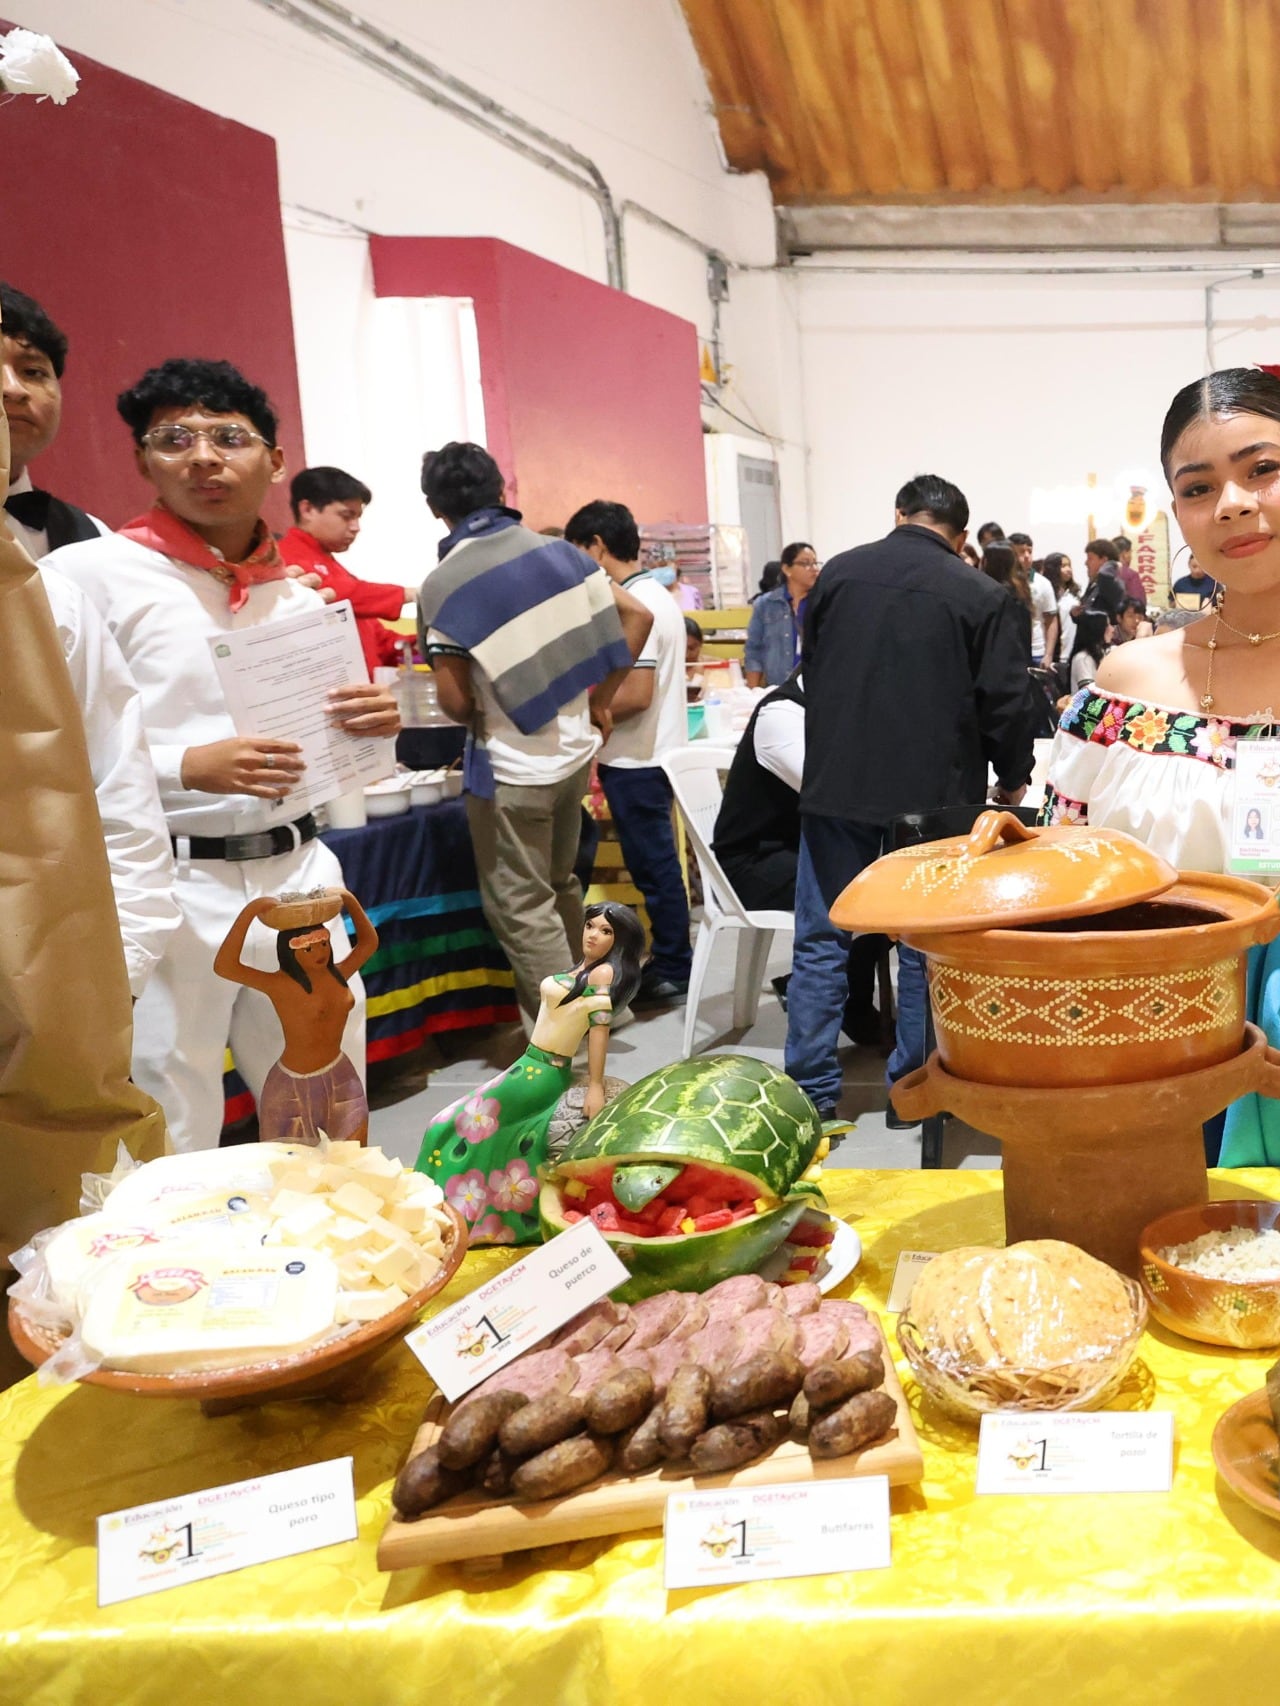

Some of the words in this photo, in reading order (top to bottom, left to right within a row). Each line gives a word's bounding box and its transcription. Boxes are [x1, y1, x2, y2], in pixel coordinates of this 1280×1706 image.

[1137, 529, 1156, 594] FARRAS
[549, 1256, 579, 1279] Queso
[580, 1245, 593, 1259] de
[564, 1262, 597, 1290] puerco
[479, 1264, 527, 1301] DGETAyCM
[427, 1304, 470, 1337] Educación
[1111, 1431, 1143, 1440] Tortilla
[1146, 1430, 1158, 1439] de
[1033, 1439, 1052, 1471] 1
[124, 1503, 183, 1525] Educación
[198, 1484, 261, 1505] DGETAyCM
[268, 1498, 309, 1514] Queso
[312, 1491, 335, 1505] tipo
[690, 1499, 739, 1509] Educación
[753, 1491, 808, 1503] DGETAyCM
[289, 1513, 318, 1528] poro
[821, 1522, 874, 1534] Butifarras
[731, 1520, 754, 1558] 1
